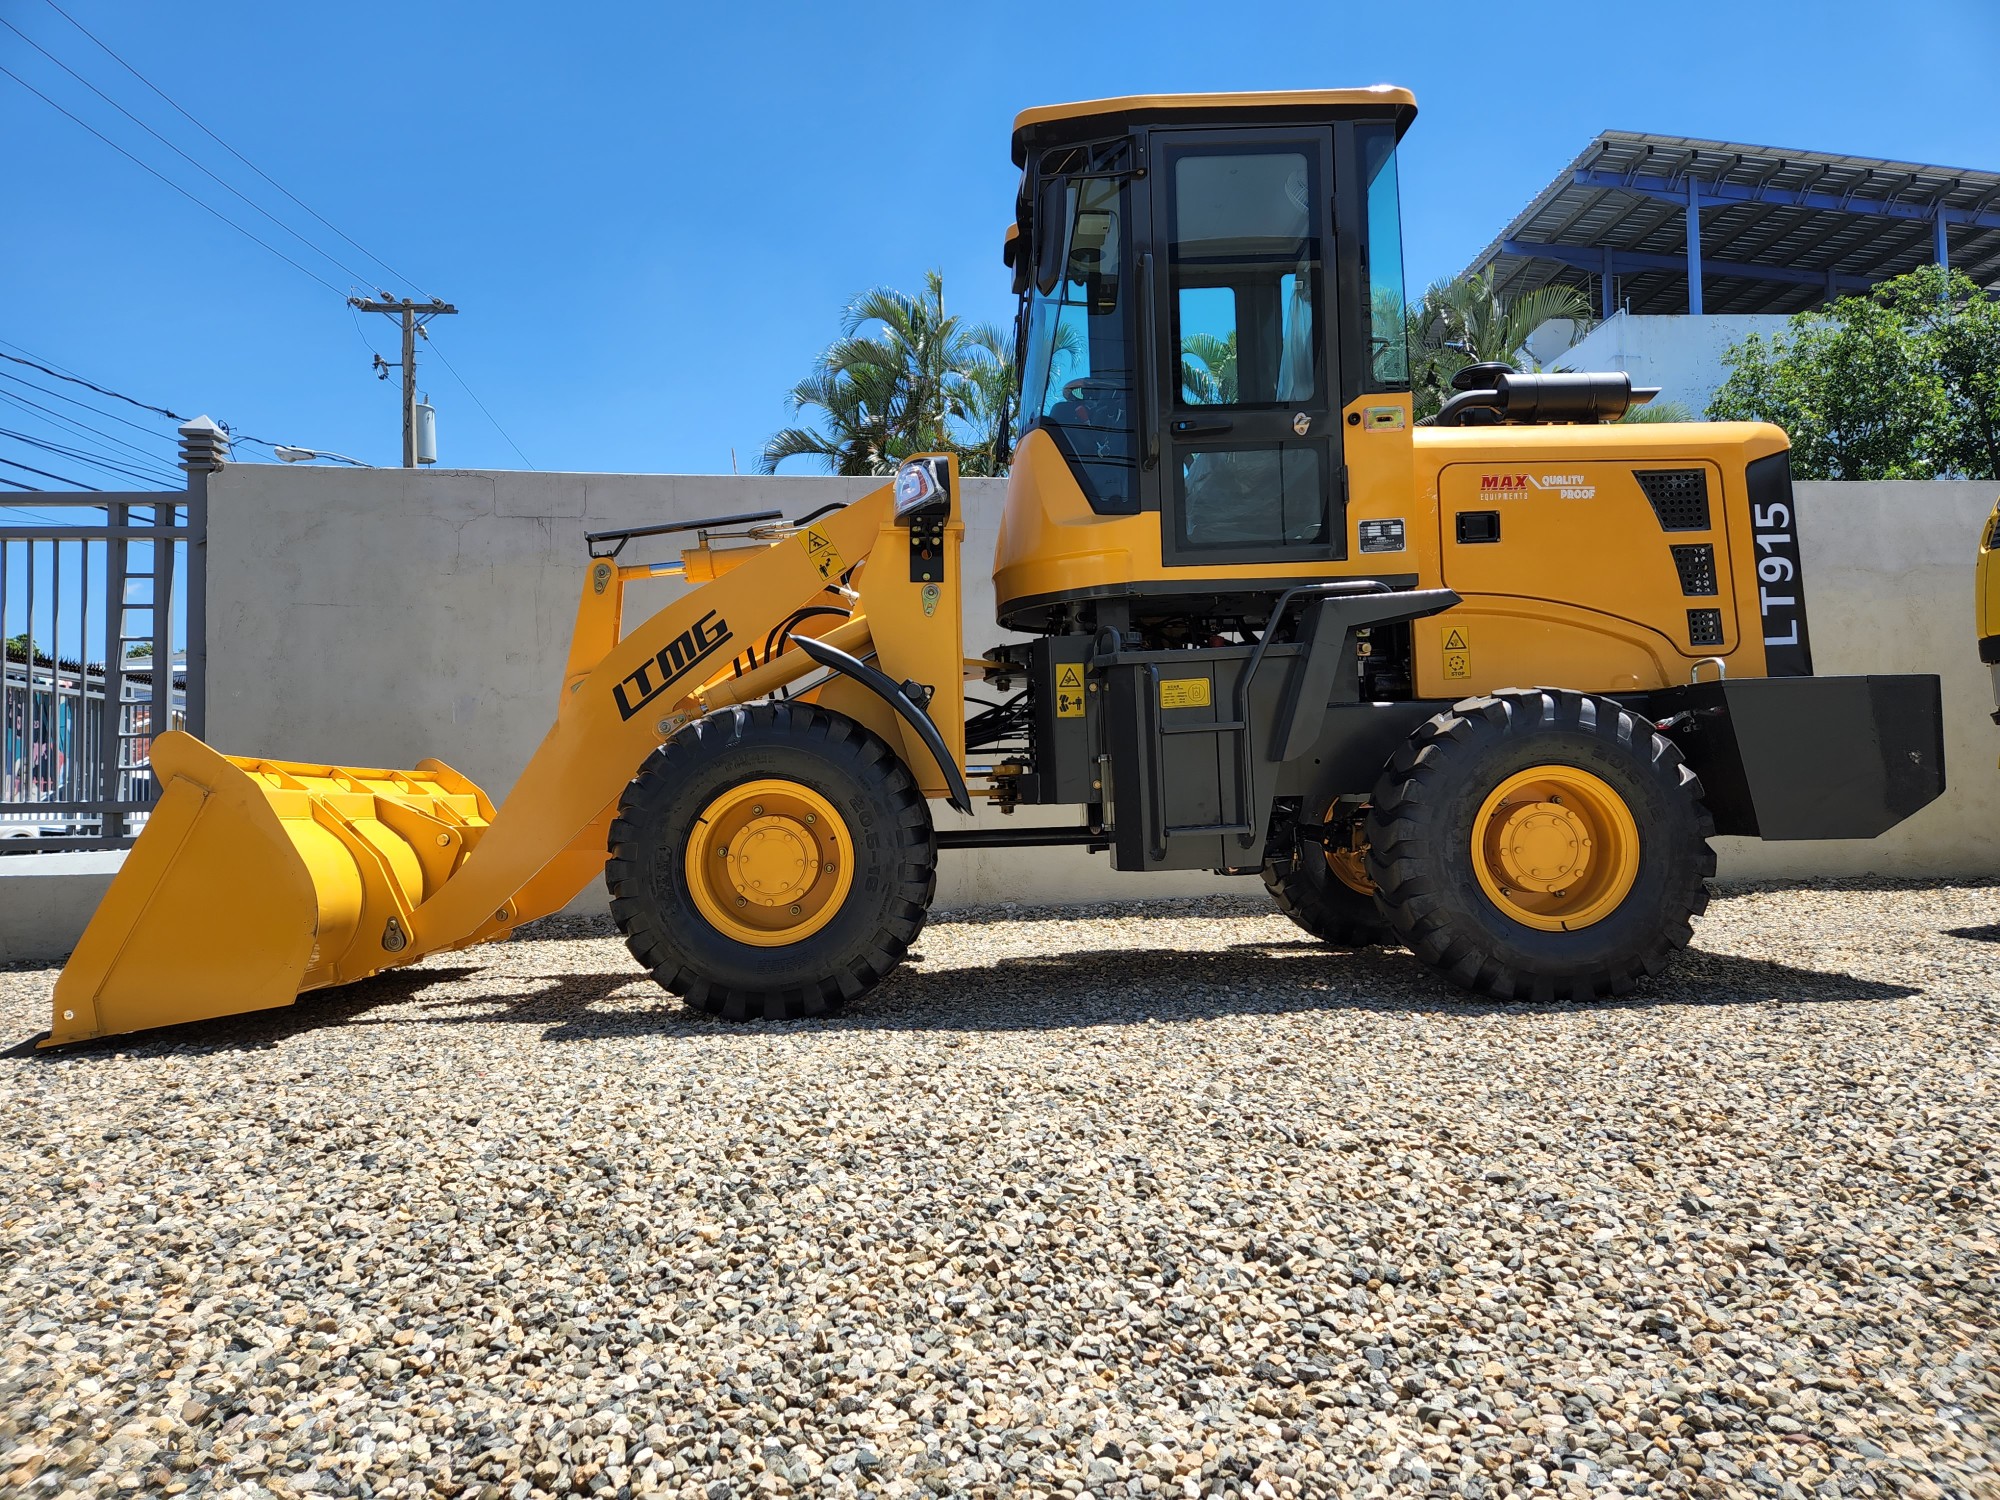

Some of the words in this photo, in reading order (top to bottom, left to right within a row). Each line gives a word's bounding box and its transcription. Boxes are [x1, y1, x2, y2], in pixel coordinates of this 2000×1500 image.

[1480, 474, 1529, 491] MAX
[1541, 475, 1585, 487] QUALITY
[1480, 492, 1528, 501] EQUIPMENTS
[1560, 489, 1596, 500] PROOF
[1754, 502, 1798, 646] LT915
[612, 609, 733, 722] LTMG
